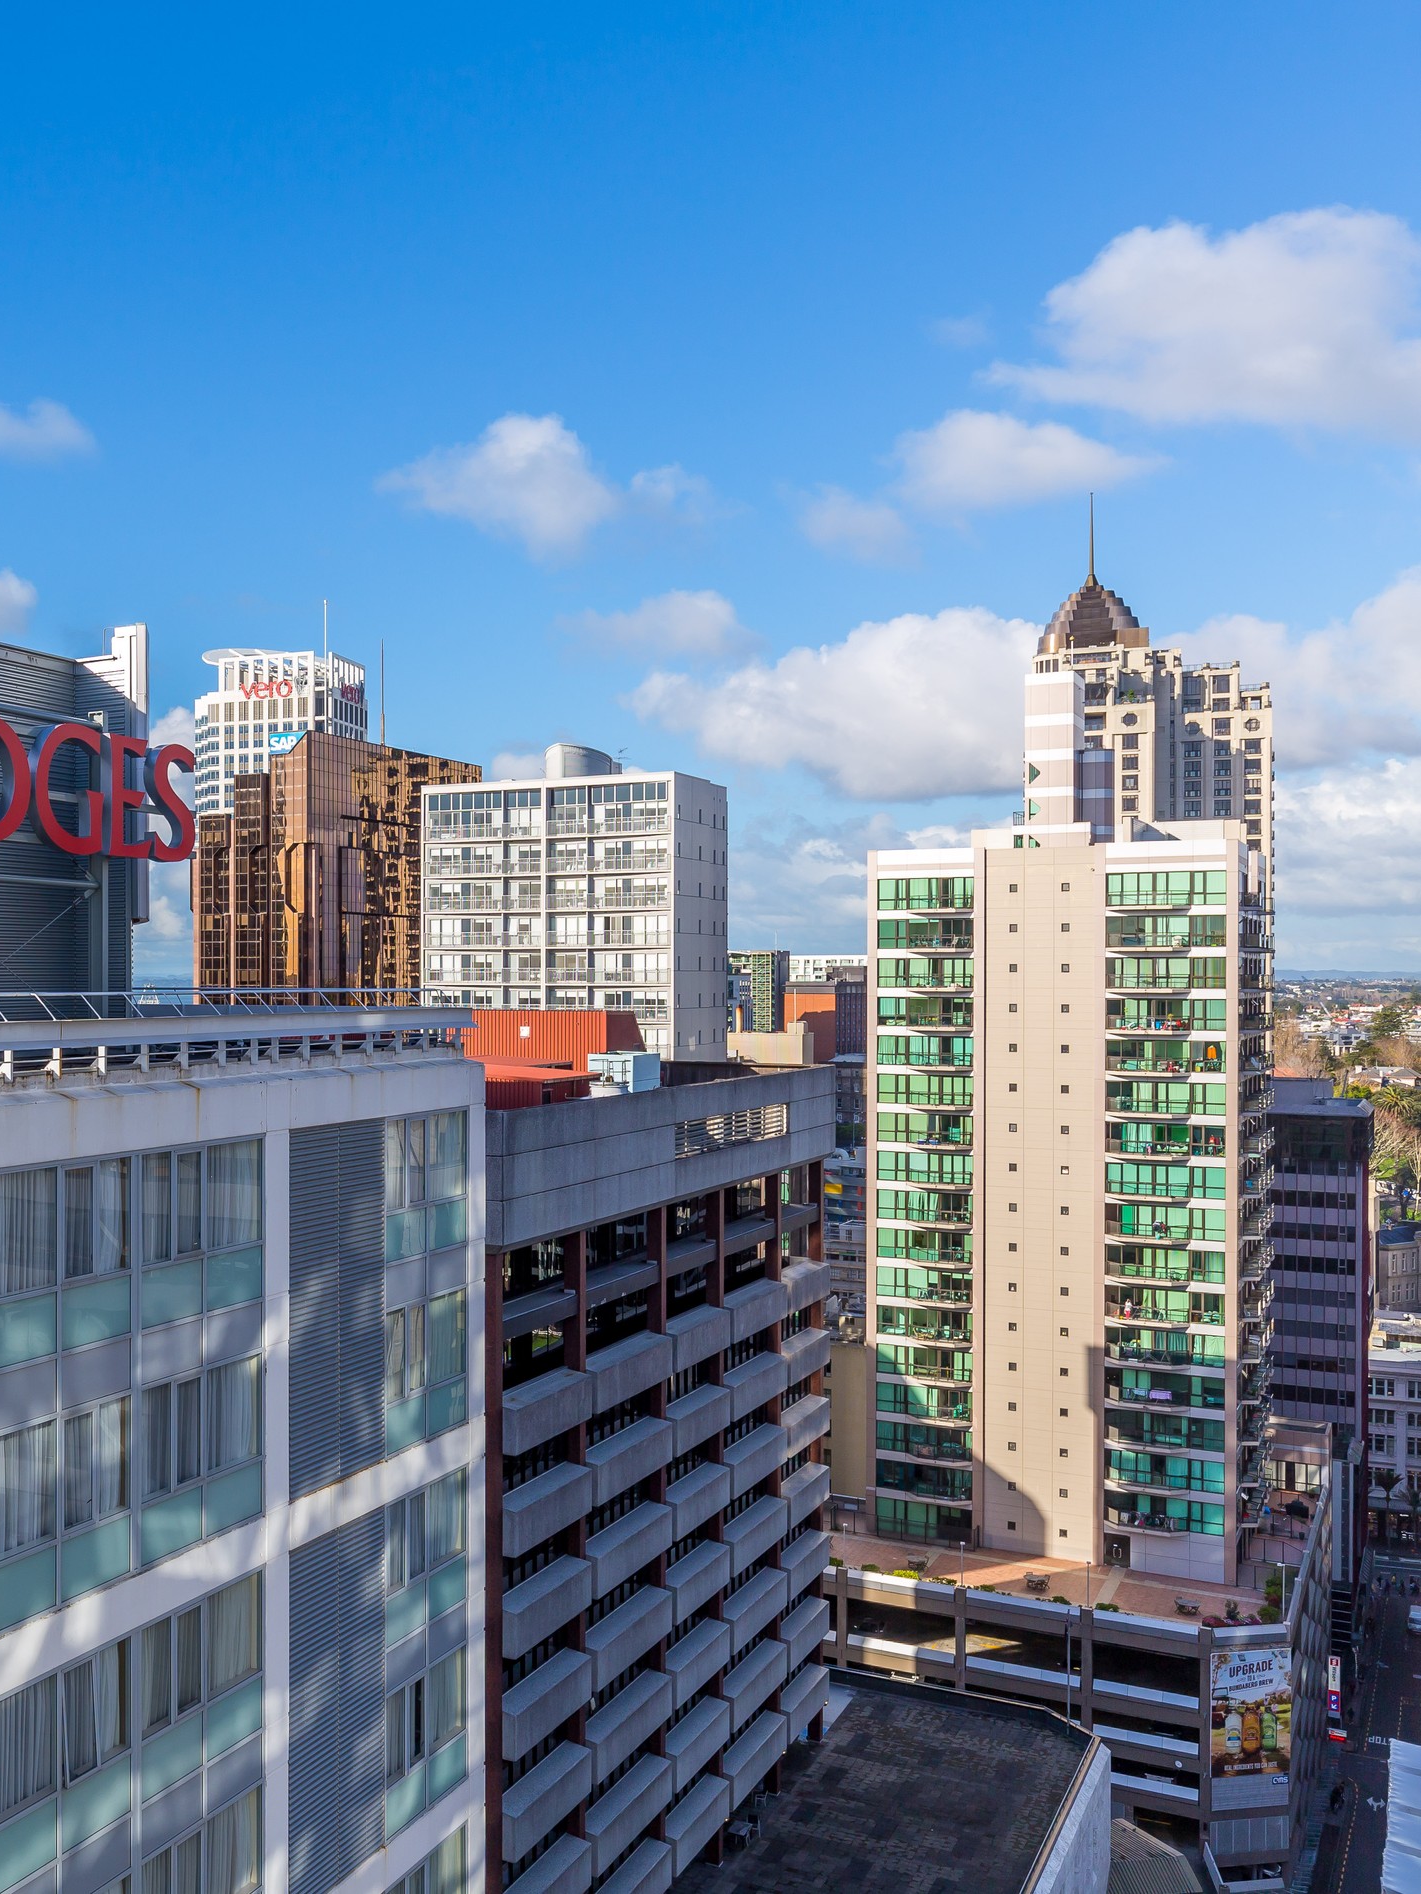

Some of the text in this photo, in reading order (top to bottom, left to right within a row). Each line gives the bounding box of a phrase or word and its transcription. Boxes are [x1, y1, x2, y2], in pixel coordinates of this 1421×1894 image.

[239, 679, 293, 700] vero
[270, 735, 297, 752] SAP
[1229, 1660, 1274, 1678] UPGRADE
[1259, 1679, 1274, 1687] BREW
[1368, 1735, 1390, 1747] TOP
